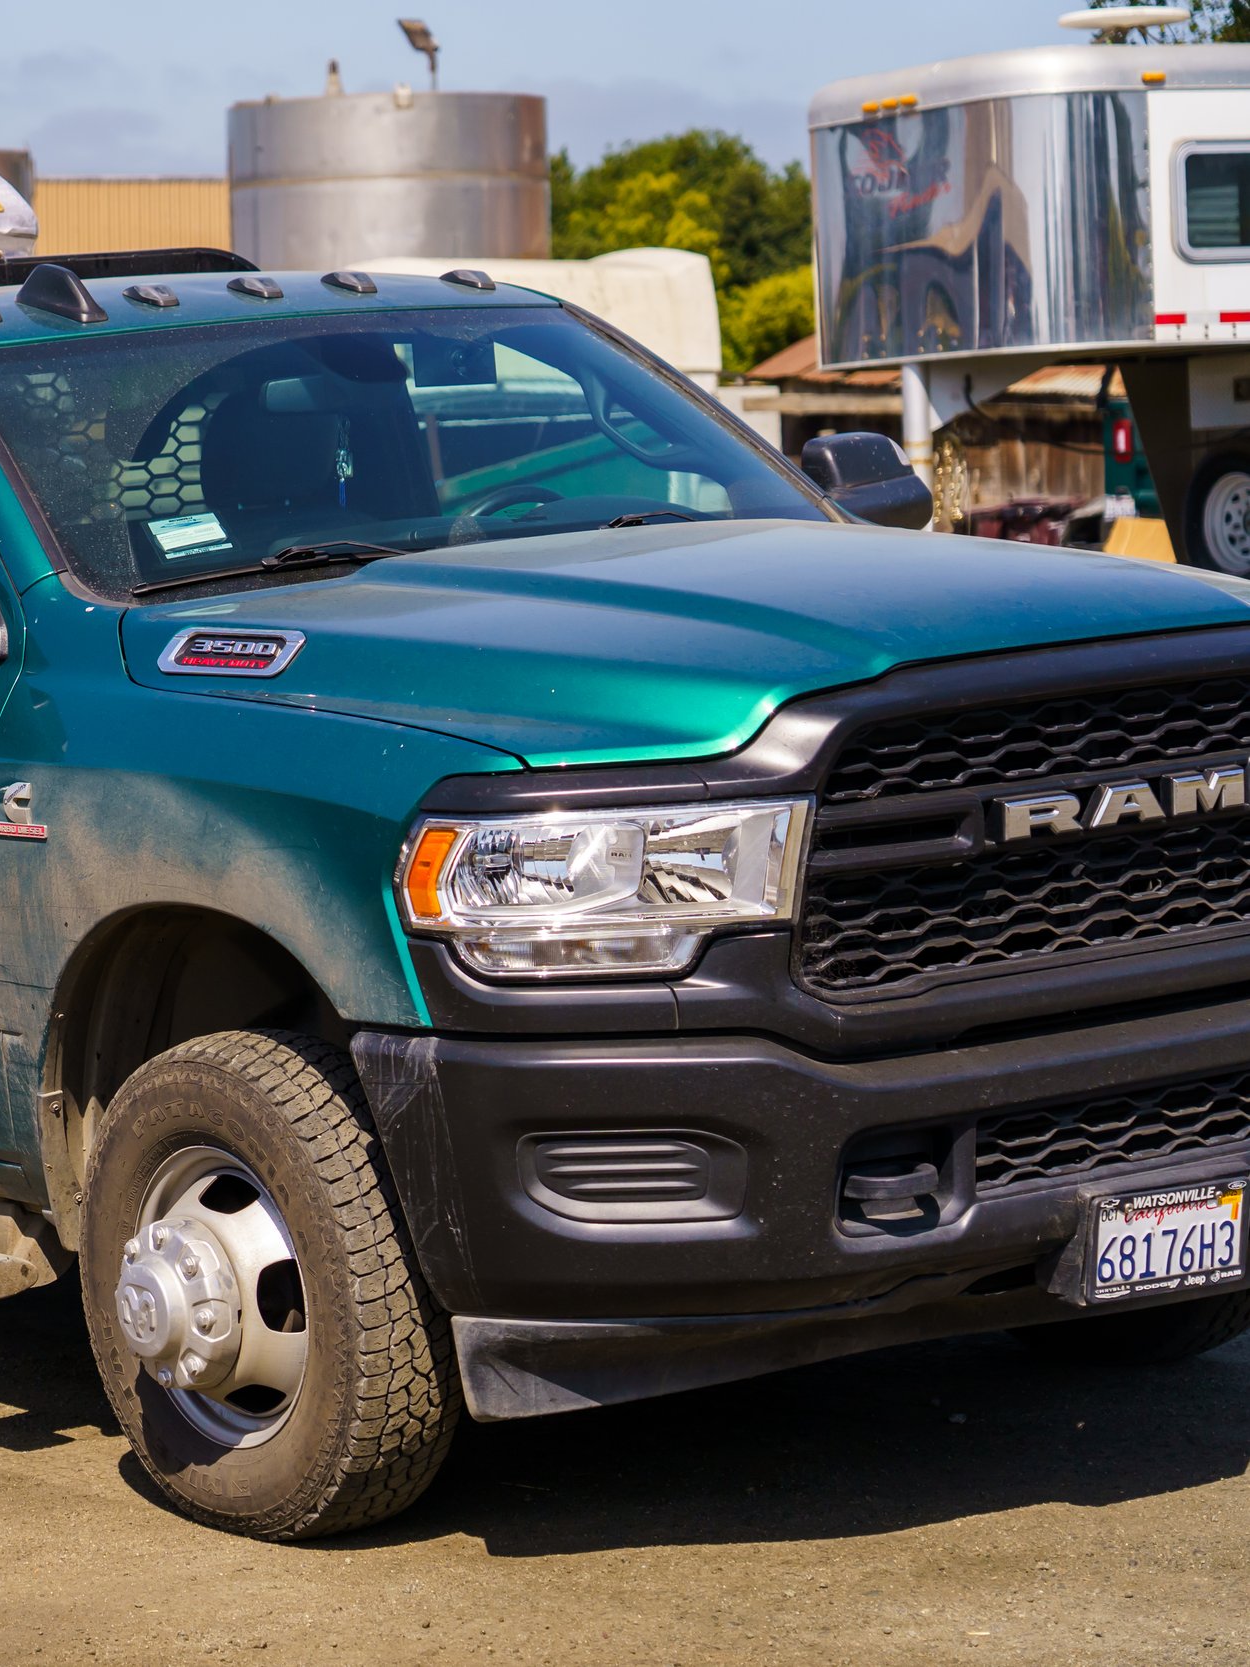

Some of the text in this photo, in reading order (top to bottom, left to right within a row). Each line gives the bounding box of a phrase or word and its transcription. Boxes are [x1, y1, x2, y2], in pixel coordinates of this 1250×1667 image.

[191, 639, 278, 657] 3500
[182, 657, 270, 669] HEAVY DUTY
[994, 764, 1246, 842] RAM
[17, 825, 45, 836] DIESEL
[131, 1098, 291, 1210] PATAGONIA
[1132, 1186, 1216, 1209] WATSONVILLE
[1101, 1208, 1119, 1222] OCT
[1098, 1220, 1235, 1283] 68176H3
[1184, 1274, 1207, 1286] Jeep
[1220, 1269, 1242, 1278] RAM
